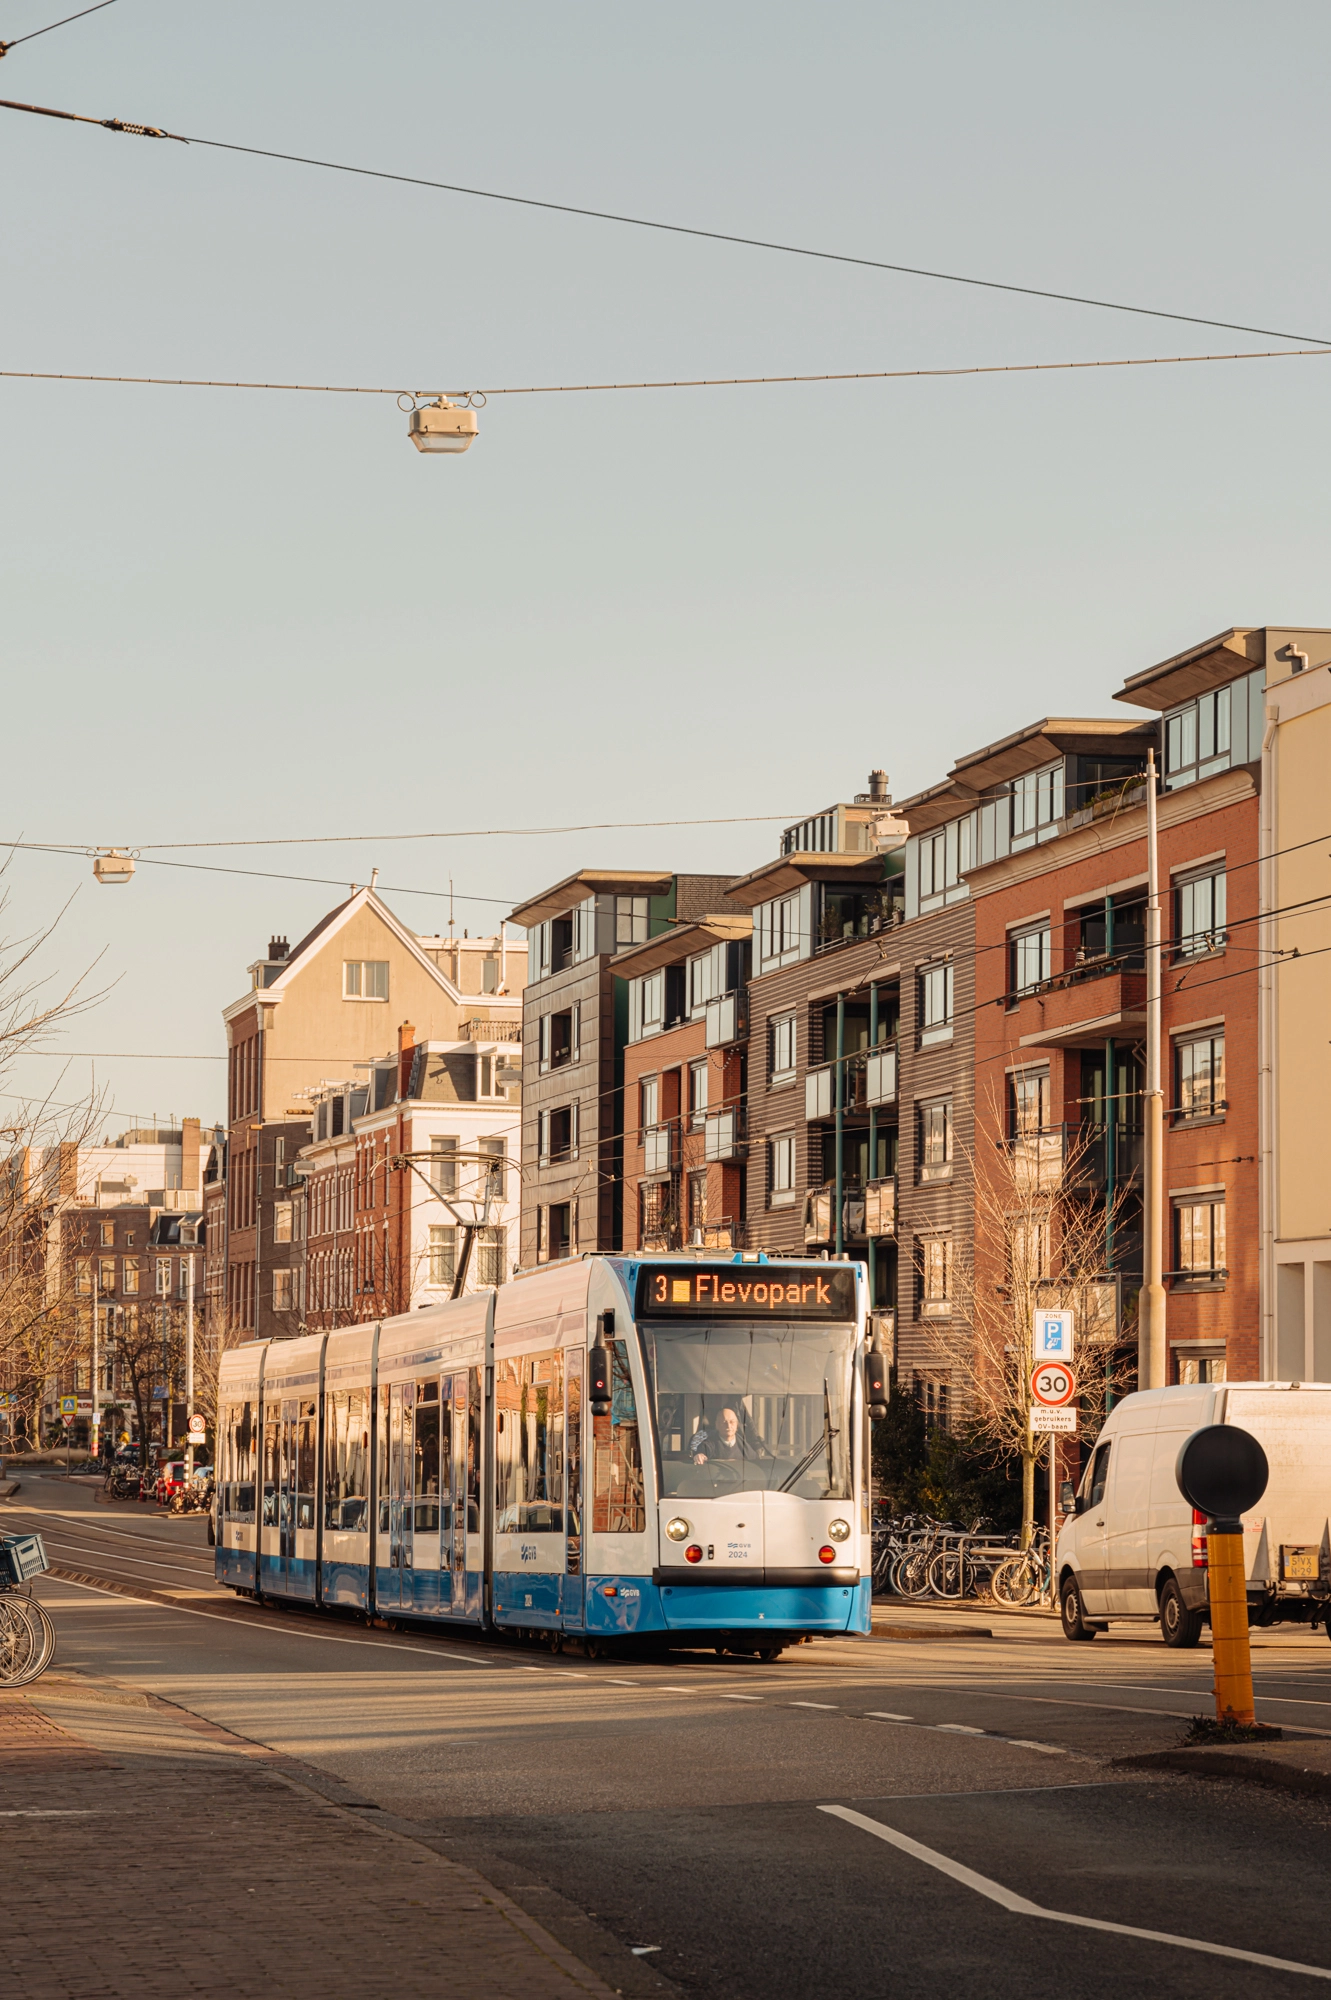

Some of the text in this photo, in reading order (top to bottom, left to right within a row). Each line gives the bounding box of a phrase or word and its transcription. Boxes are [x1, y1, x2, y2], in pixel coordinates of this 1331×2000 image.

[655, 1275, 831, 1309] 3 Flevopark
[1047, 1323, 1059, 1338] P
[1039, 1376, 1067, 1392] 30
[728, 1551, 748, 1559] 2024
[629, 1589, 640, 1597] GVB
